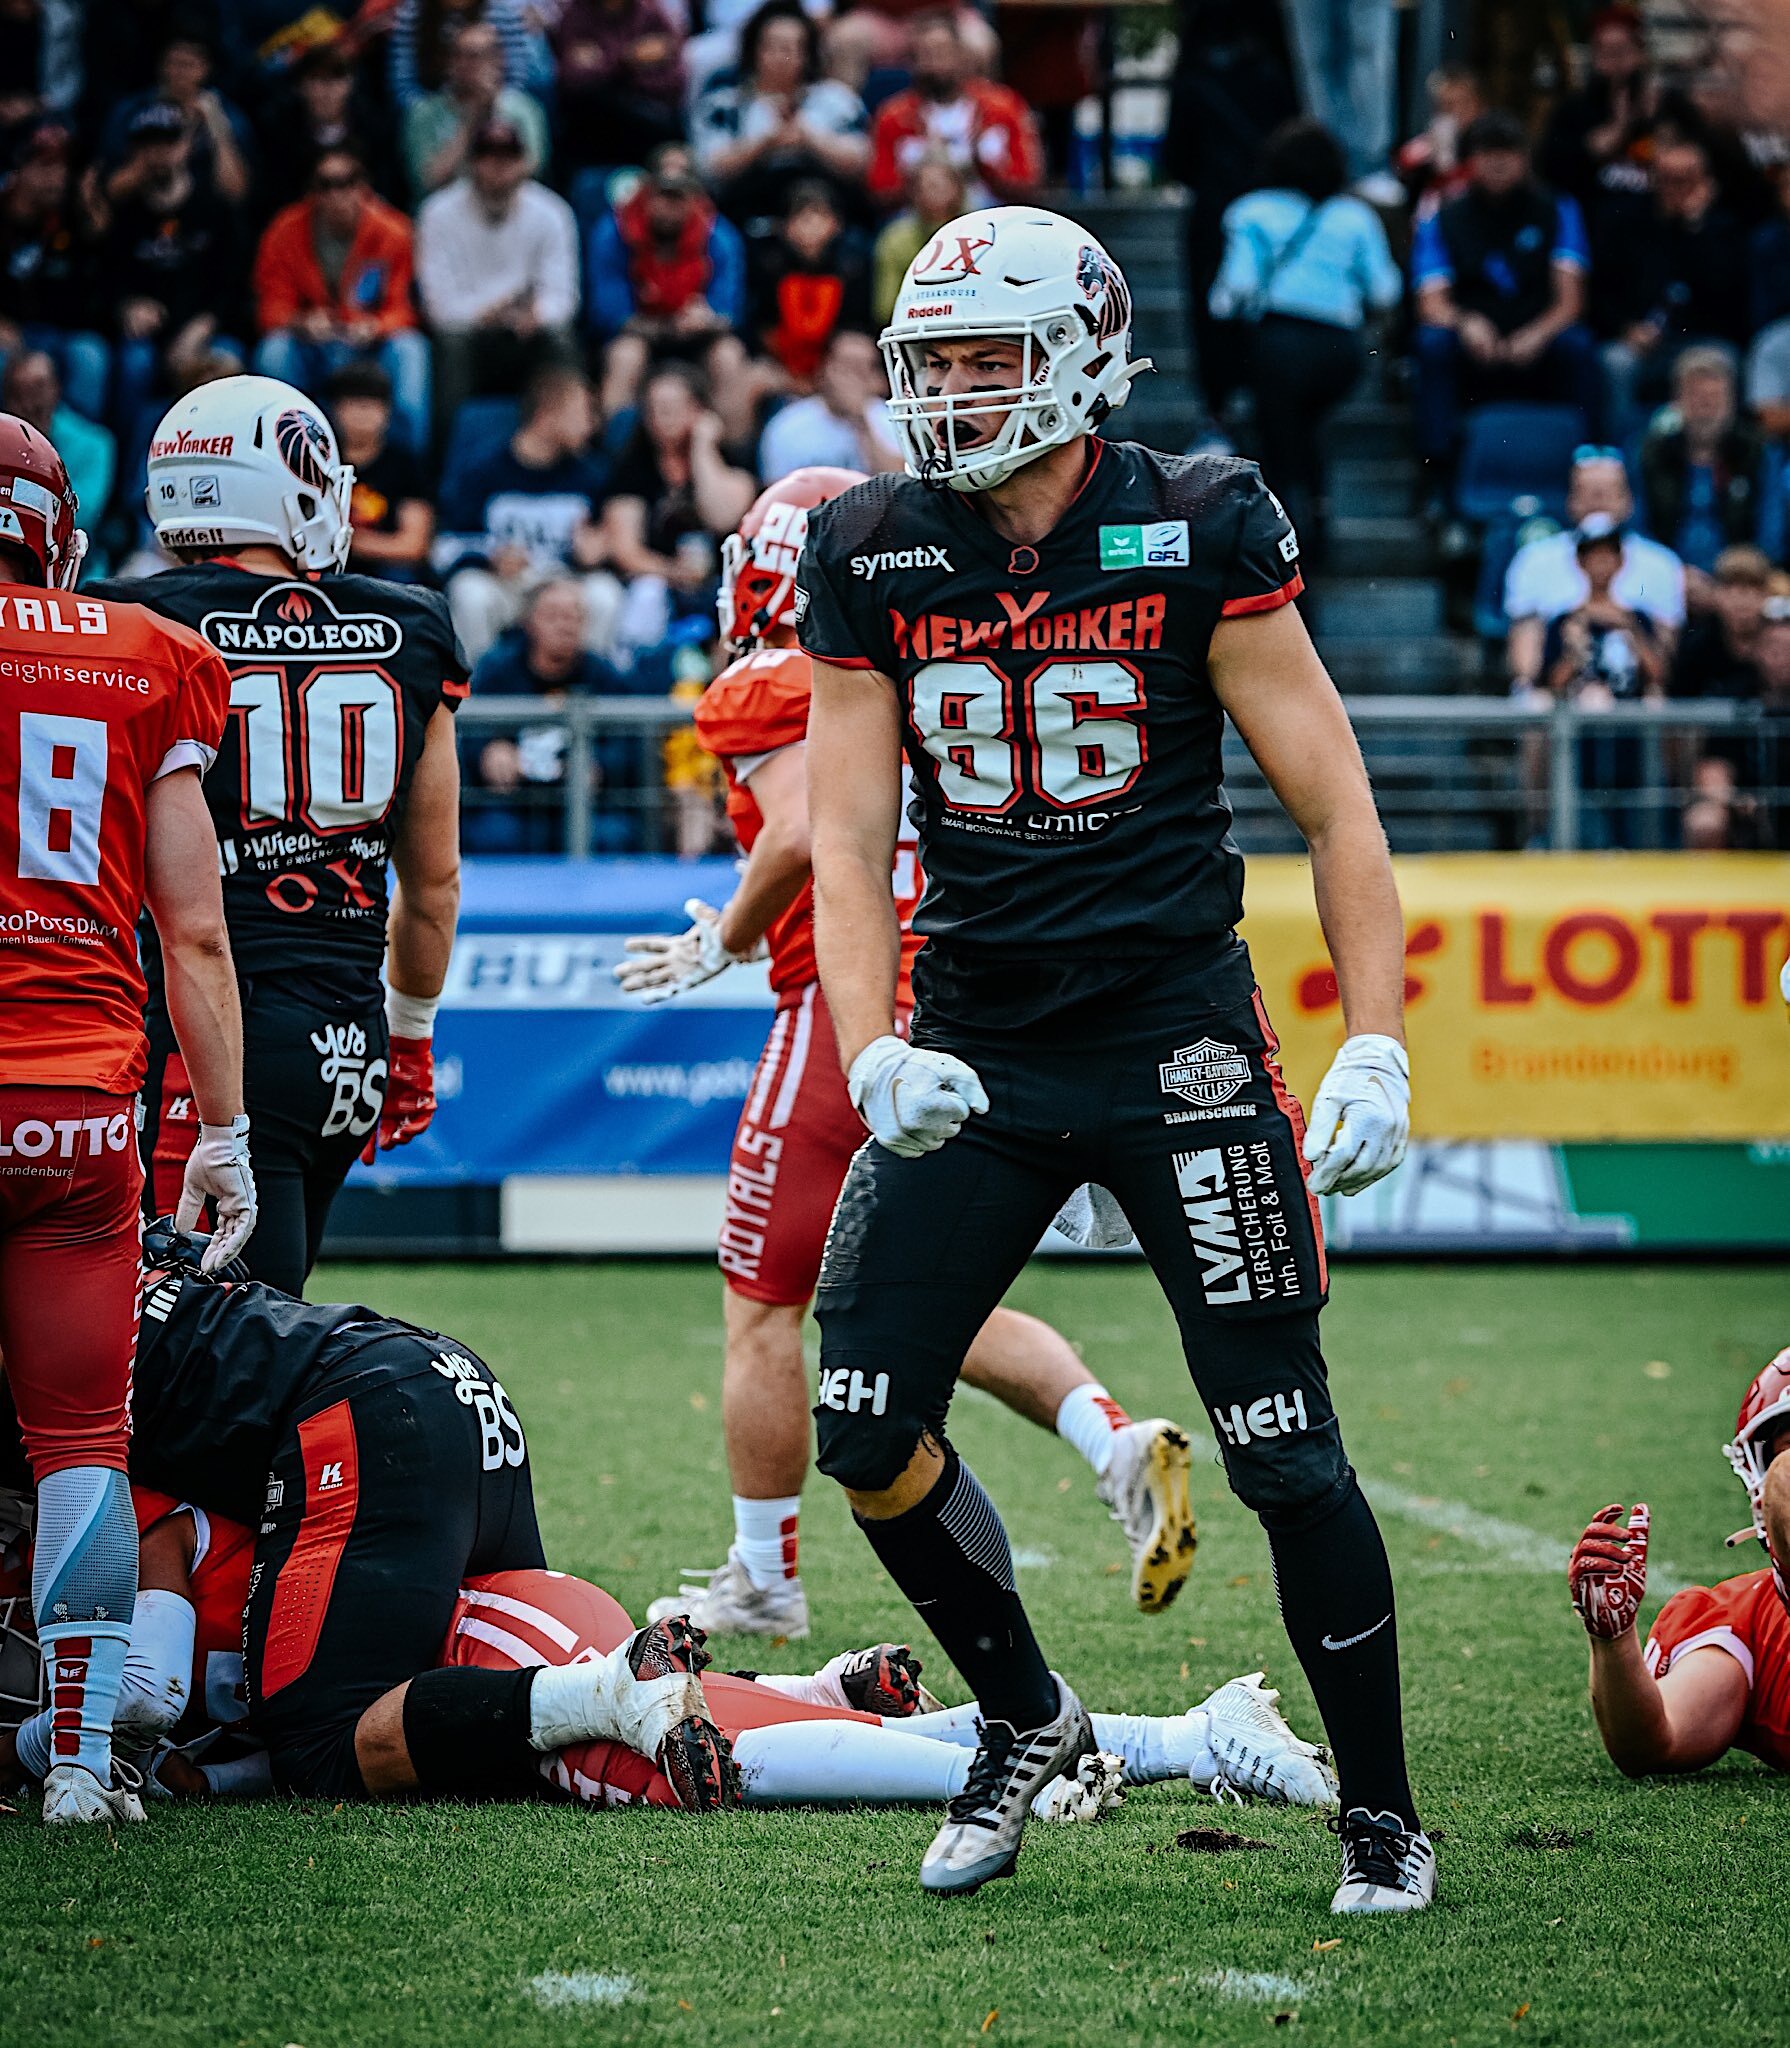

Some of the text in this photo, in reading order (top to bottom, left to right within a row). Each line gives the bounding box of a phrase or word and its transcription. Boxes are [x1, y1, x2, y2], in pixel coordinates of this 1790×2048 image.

[907, 304, 953, 319] Riddell
[160, 484, 175, 499] 10
[1148, 550, 1185, 562] GFL
[216, 623, 386, 649] NAPOLEON
[229, 664, 404, 831] 10
[907, 656, 1148, 815] 86
[18, 712, 108, 886] 8
[1478, 911, 1790, 1006] LOTT
[321, 1058, 388, 1137] BS
[1163, 1103, 1257, 1125] BRAUNSCHWEIG
[1189, 1081, 1231, 1099] CYCLES
[0, 1165, 75, 1180] randenburg
[717, 1124, 784, 1281] ROYALS
[1227, 1145, 1276, 1300] VERSICHERUNG
[1249, 1141, 1300, 1297] Inh. Foit & Molt
[474, 1381, 525, 1471] BS
